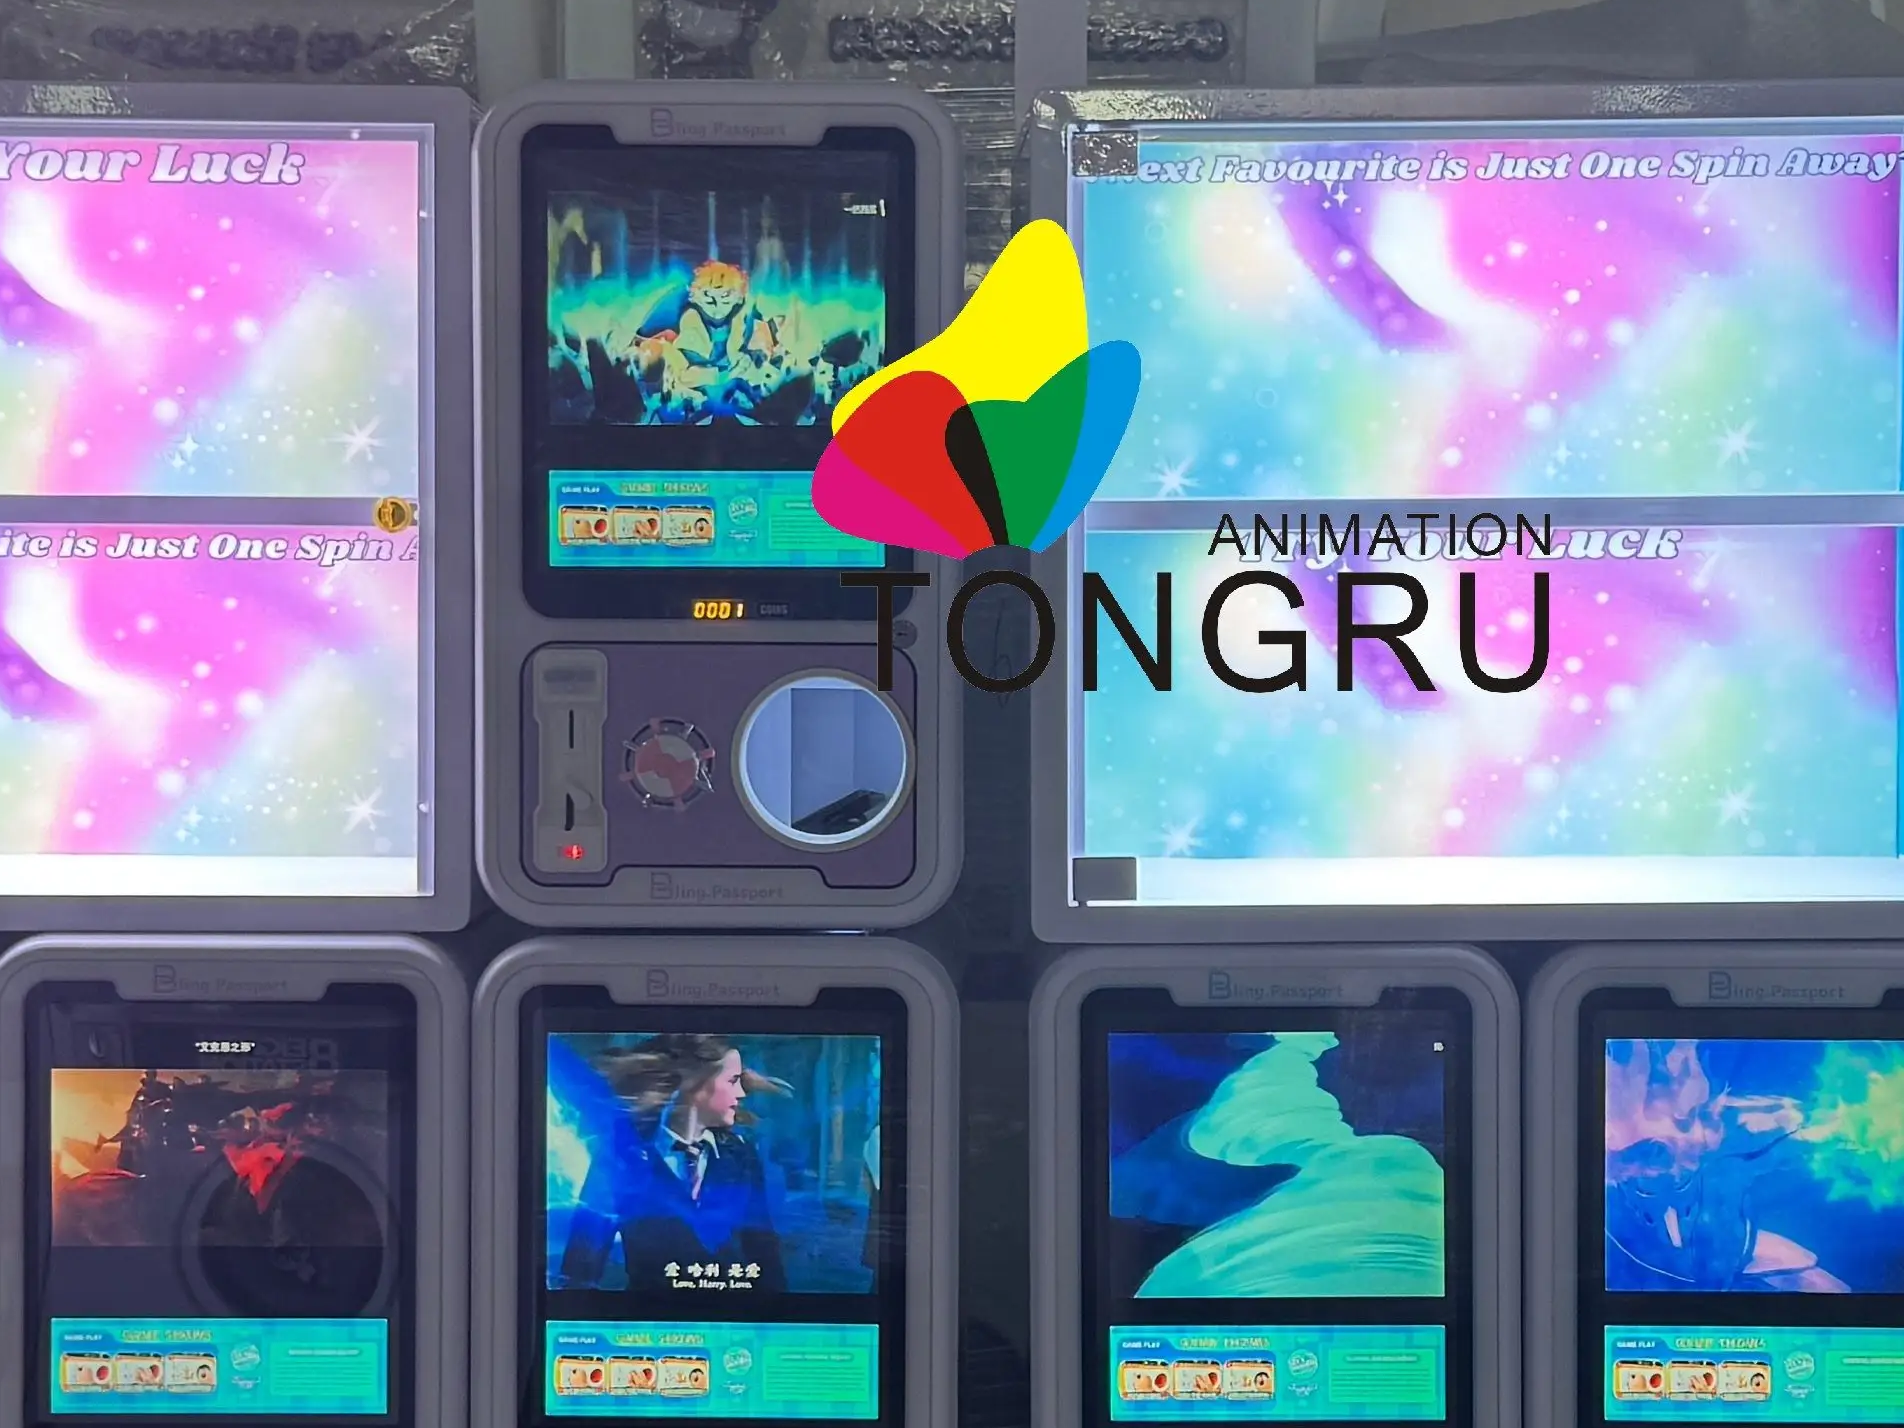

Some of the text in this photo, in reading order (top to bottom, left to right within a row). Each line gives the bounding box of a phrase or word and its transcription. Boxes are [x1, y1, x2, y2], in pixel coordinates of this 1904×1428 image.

[148, 144, 305, 185] Luck
[1209, 152, 1428, 183] Favourite
[1431, 152, 1468, 182] is
[1476, 151, 1571, 181] Just
[1580, 151, 1661, 181] One
[1668, 148, 1773, 183] Spin
[1781, 149, 1897, 182] Away
[59, 531, 98, 559] is
[106, 532, 199, 560] Just
[203, 533, 290, 561] One
[295, 534, 394, 565] Spin
[1526, 529, 1683, 561] Luck
[694, 602, 743, 618] 0001
